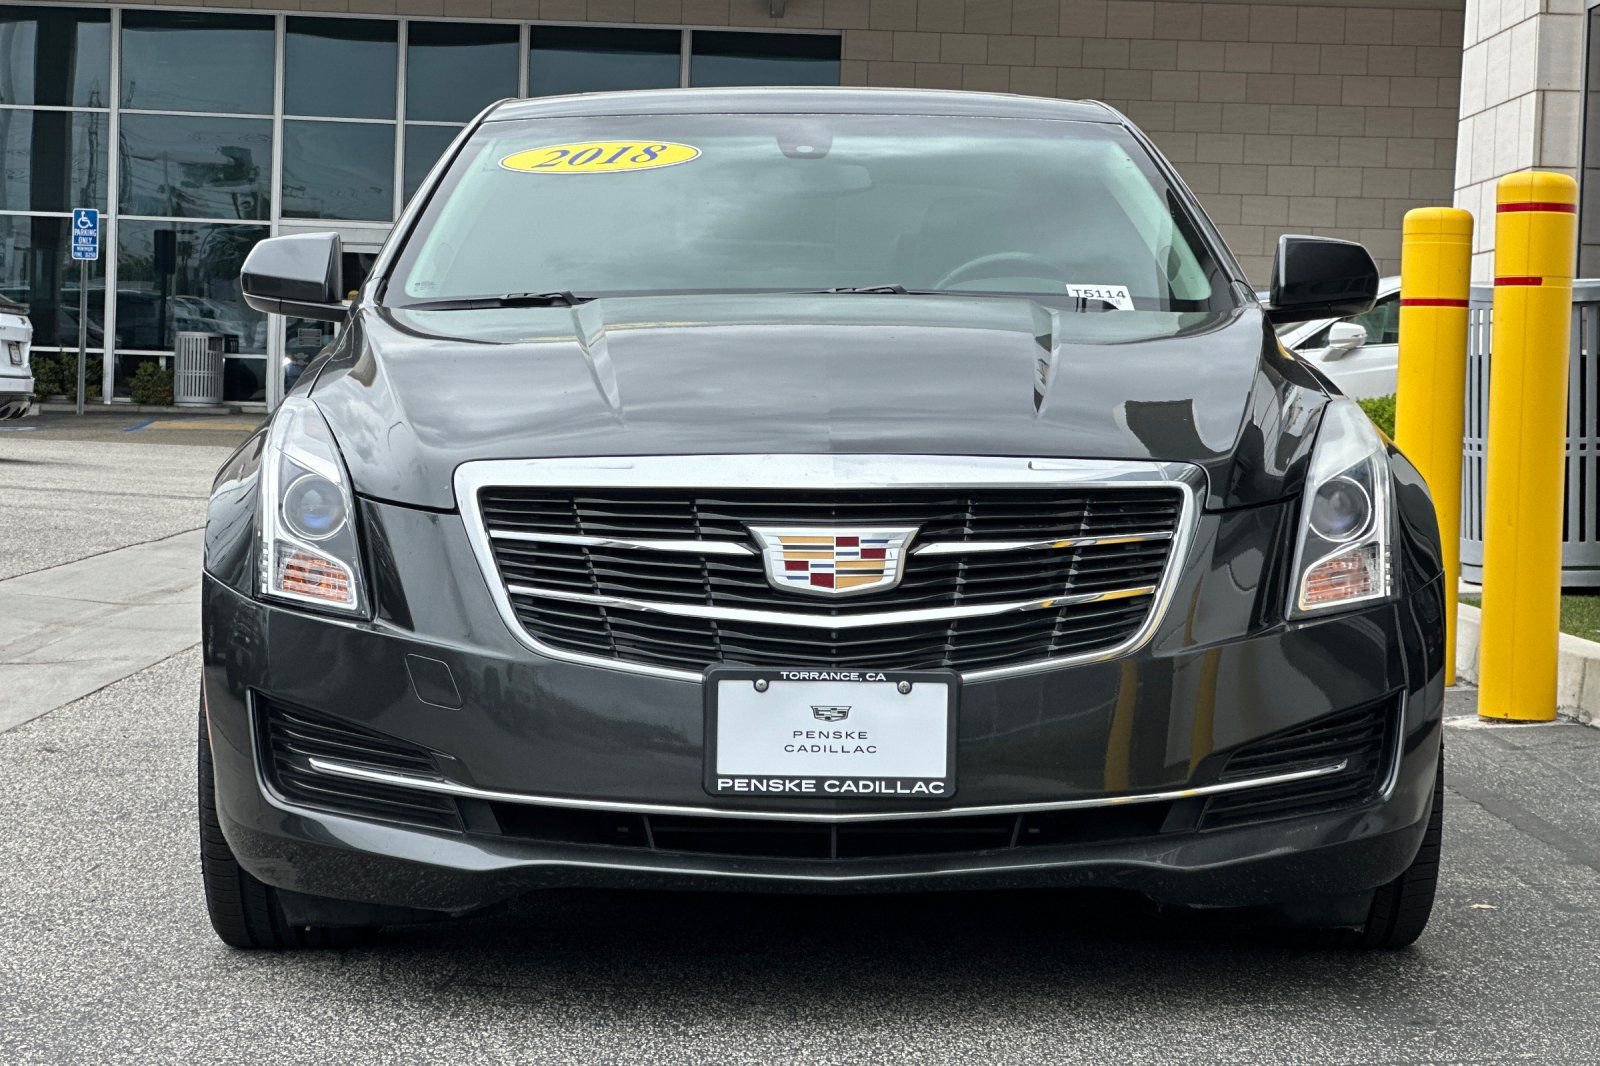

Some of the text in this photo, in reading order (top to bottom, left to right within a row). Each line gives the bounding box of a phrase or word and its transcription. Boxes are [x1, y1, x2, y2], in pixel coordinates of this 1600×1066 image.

[530, 145, 667, 168] 2018
[74, 228, 97, 237] PARKING
[78, 236, 93, 244] ONLY
[1072, 289, 1126, 299] T5114
[780, 671, 887, 682] TORRANCE, CA
[793, 730, 868, 740] PENSKE
[784, 744, 877, 754] CADILLAC
[717, 779, 945, 794] PENSKE CADILLAC
